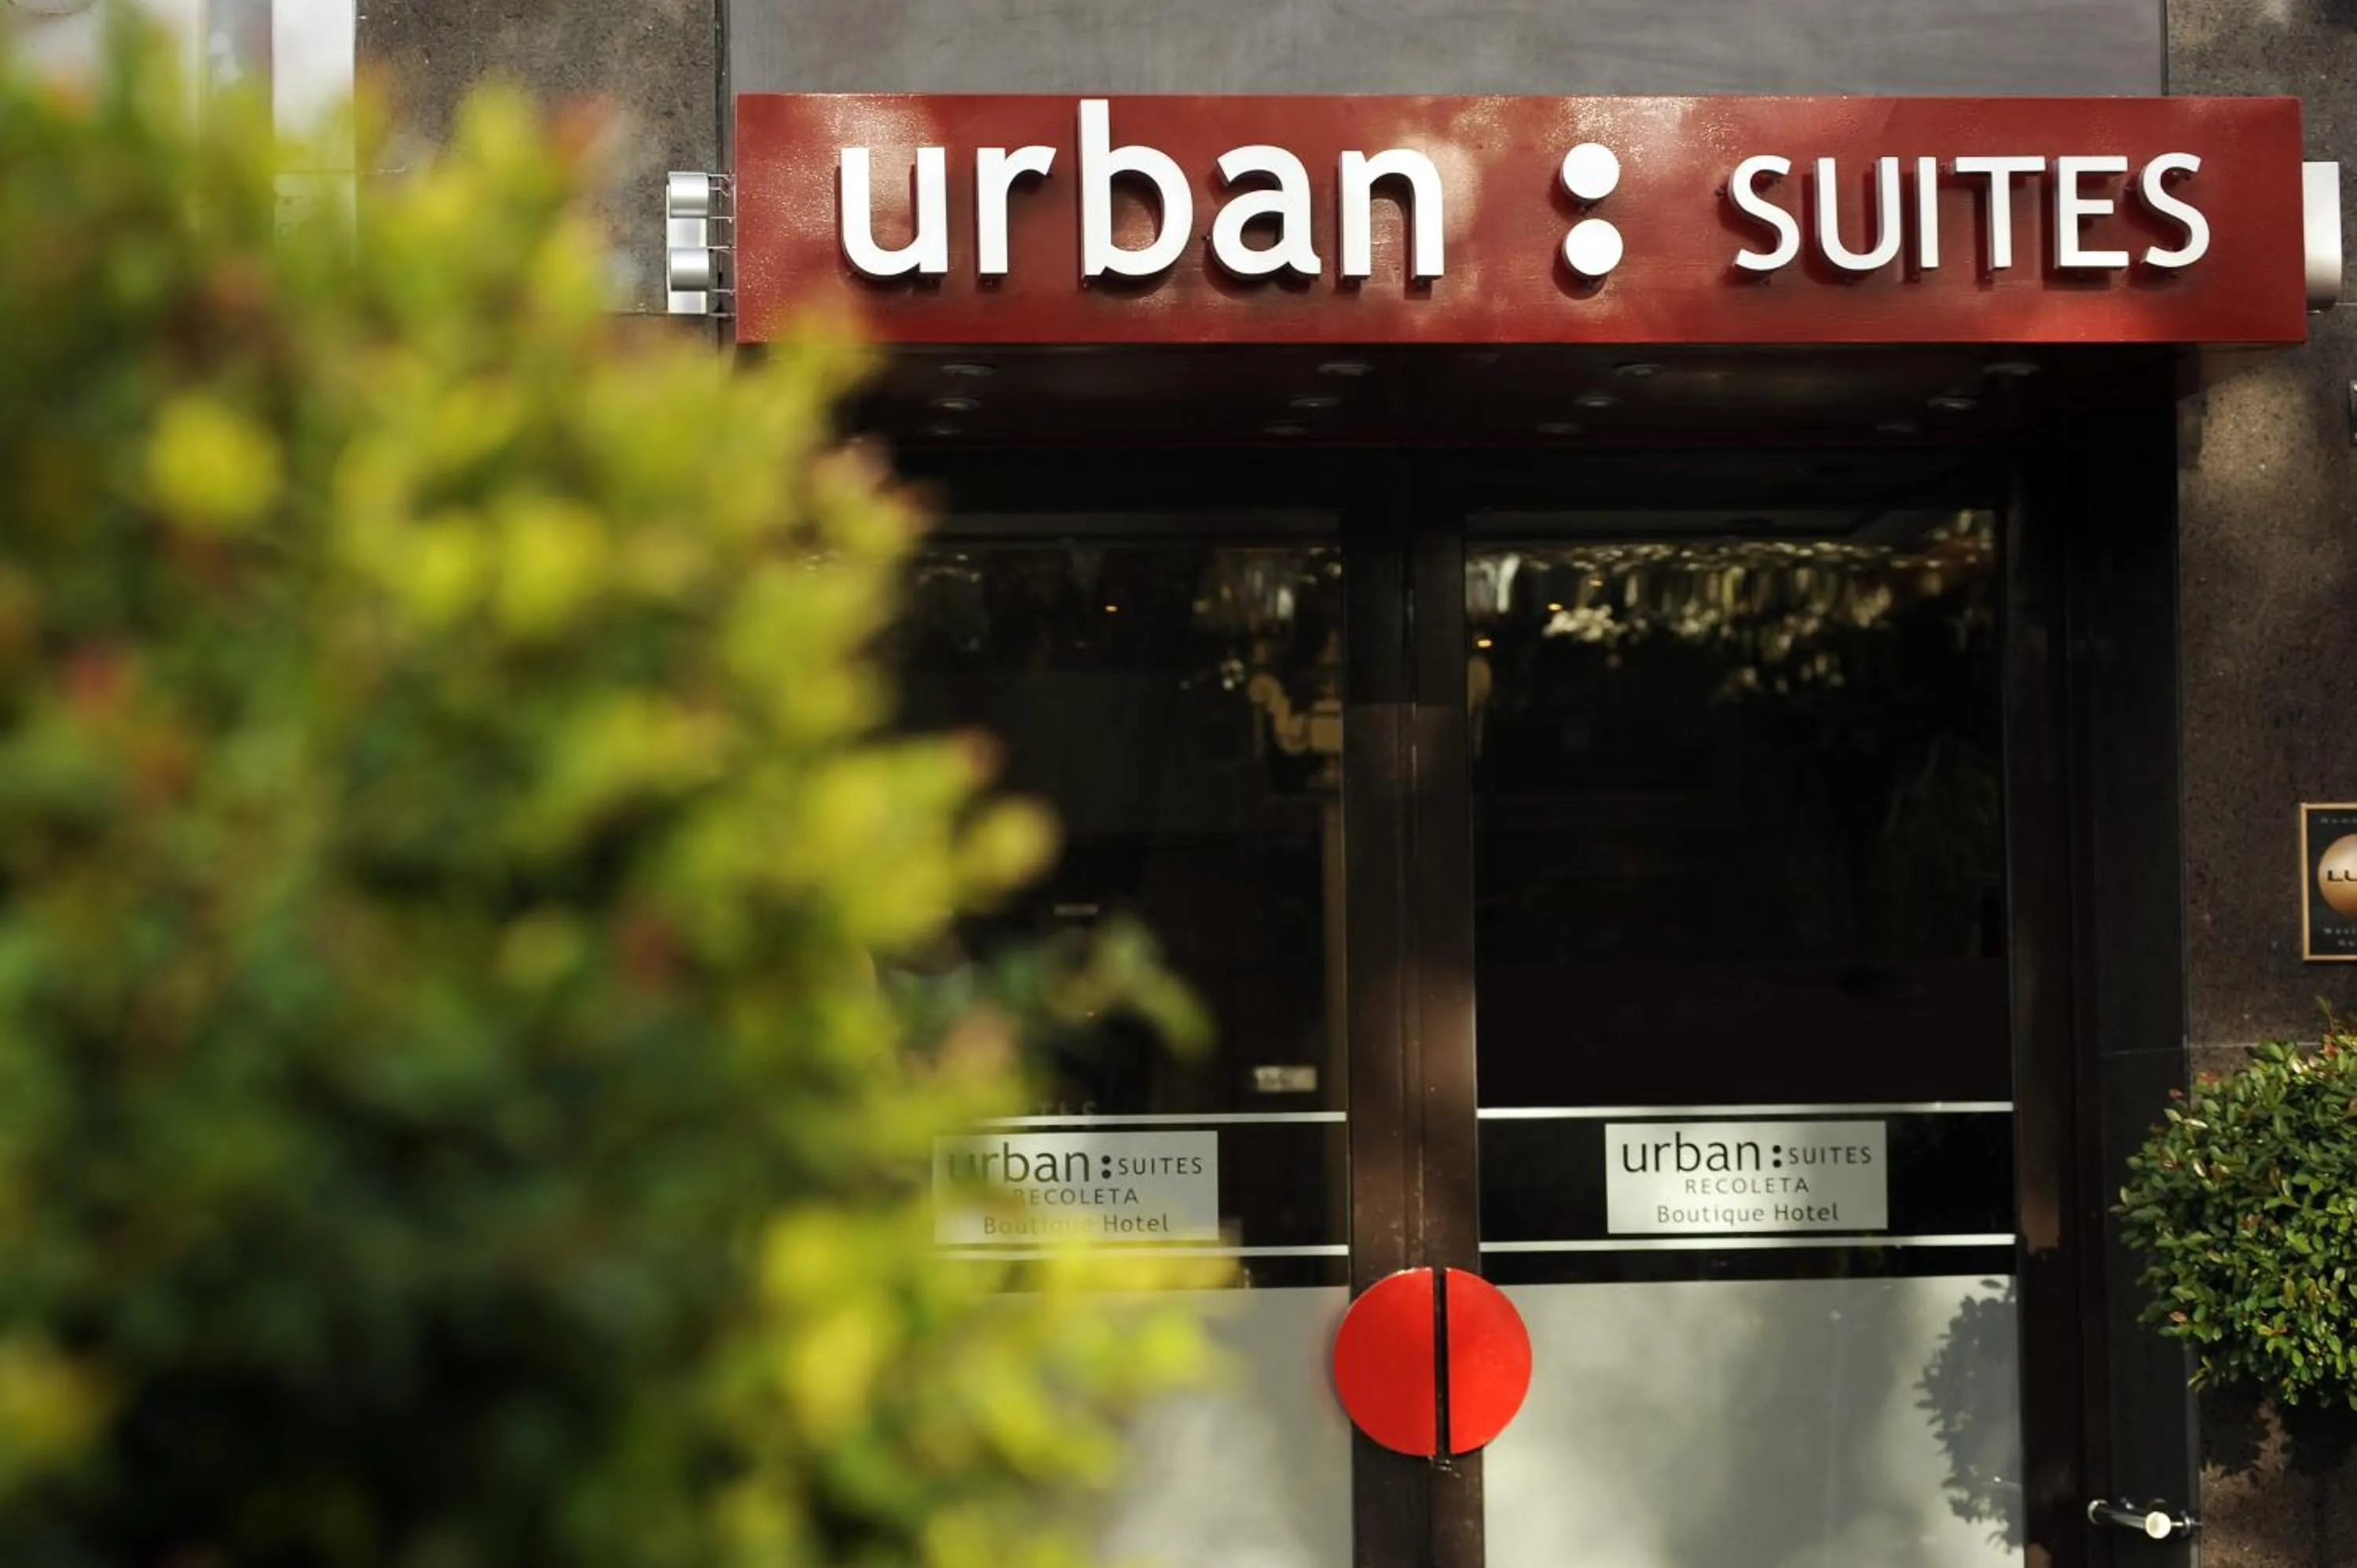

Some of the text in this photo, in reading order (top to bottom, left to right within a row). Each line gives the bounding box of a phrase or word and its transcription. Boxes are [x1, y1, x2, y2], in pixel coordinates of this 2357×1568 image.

[838, 98, 1444, 280] urban
[1731, 152, 2211, 272] SUITES
[1684, 1177, 1810, 1195] RECOLETA
[1102, 1213, 1170, 1233] Hotel
[1656, 1203, 1840, 1226] Boutique Hotel
